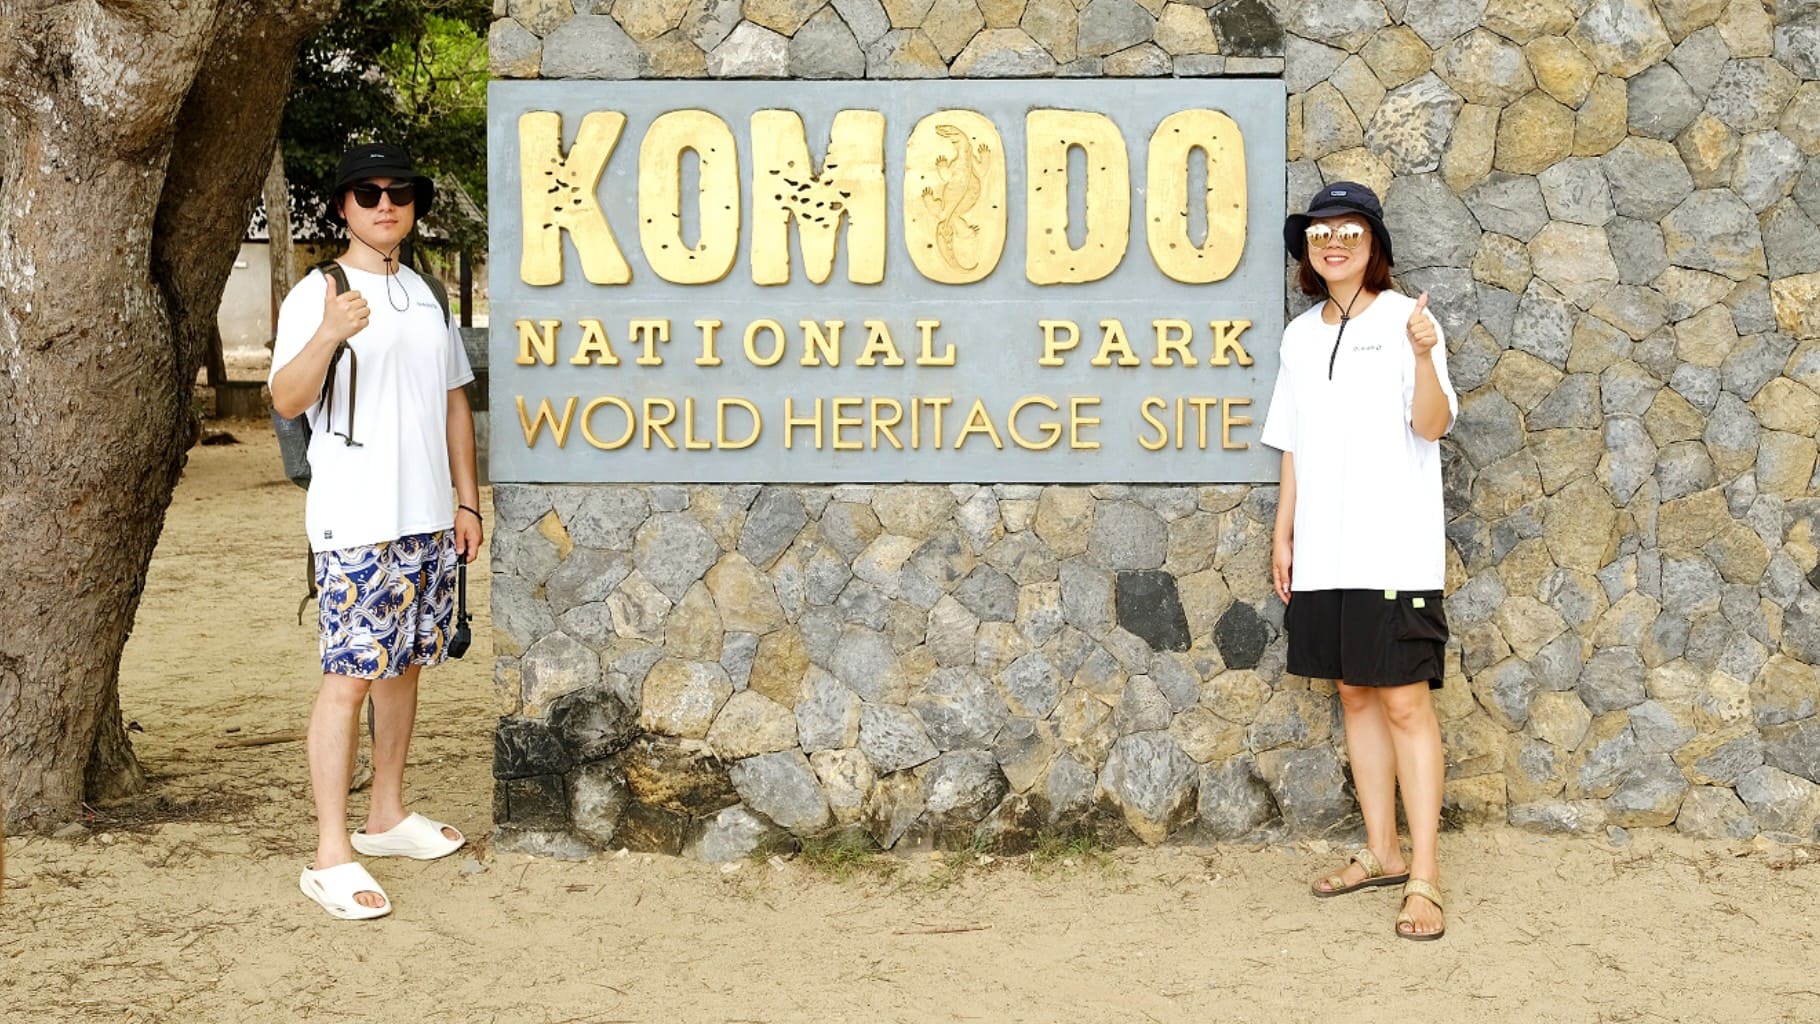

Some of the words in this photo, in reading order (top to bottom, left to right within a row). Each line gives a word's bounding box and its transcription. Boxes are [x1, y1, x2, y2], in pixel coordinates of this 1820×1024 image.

[518, 108, 1248, 287] KOMODO
[514, 318, 957, 367] NATIONAL
[1037, 318, 1255, 367] PARK
[515, 395, 763, 450] WORLD
[784, 395, 1102, 450] HERITAGE
[1137, 396, 1254, 450] SITE
